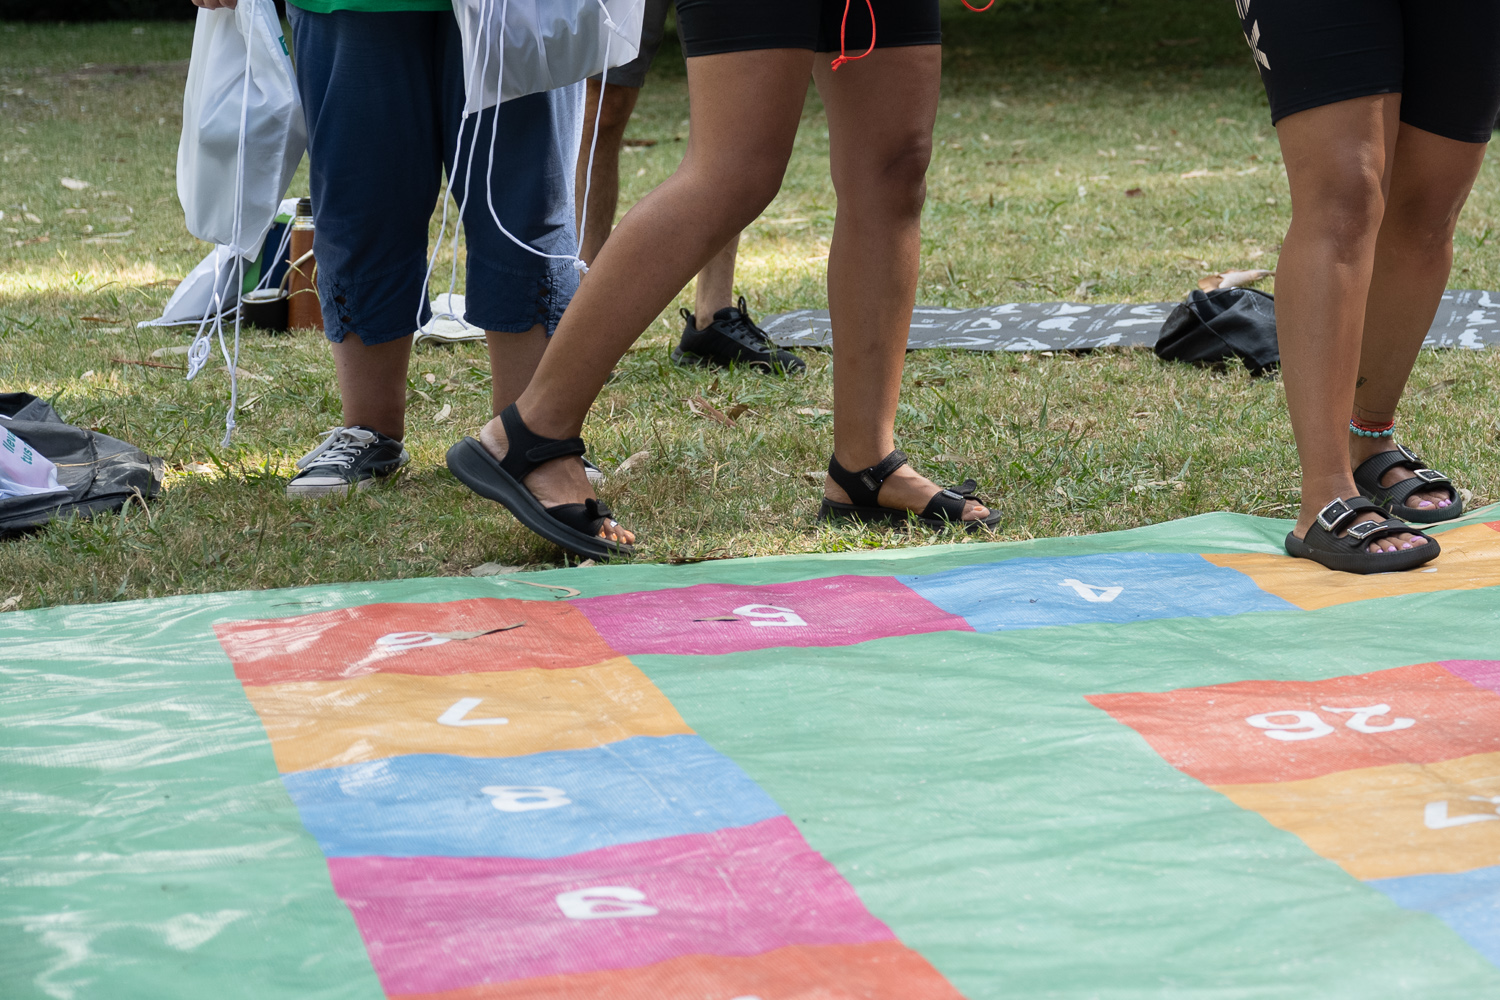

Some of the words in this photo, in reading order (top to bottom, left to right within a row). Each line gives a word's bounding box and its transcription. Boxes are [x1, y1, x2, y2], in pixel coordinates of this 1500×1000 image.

[20, 447, 33, 465] tus
[1058, 578, 1123, 603] 4
[733, 603, 807, 627] 5
[436, 697, 509, 727] 7
[1245, 703, 1416, 741] 26
[480, 785, 572, 813] 8
[555, 886, 659, 920] 9
